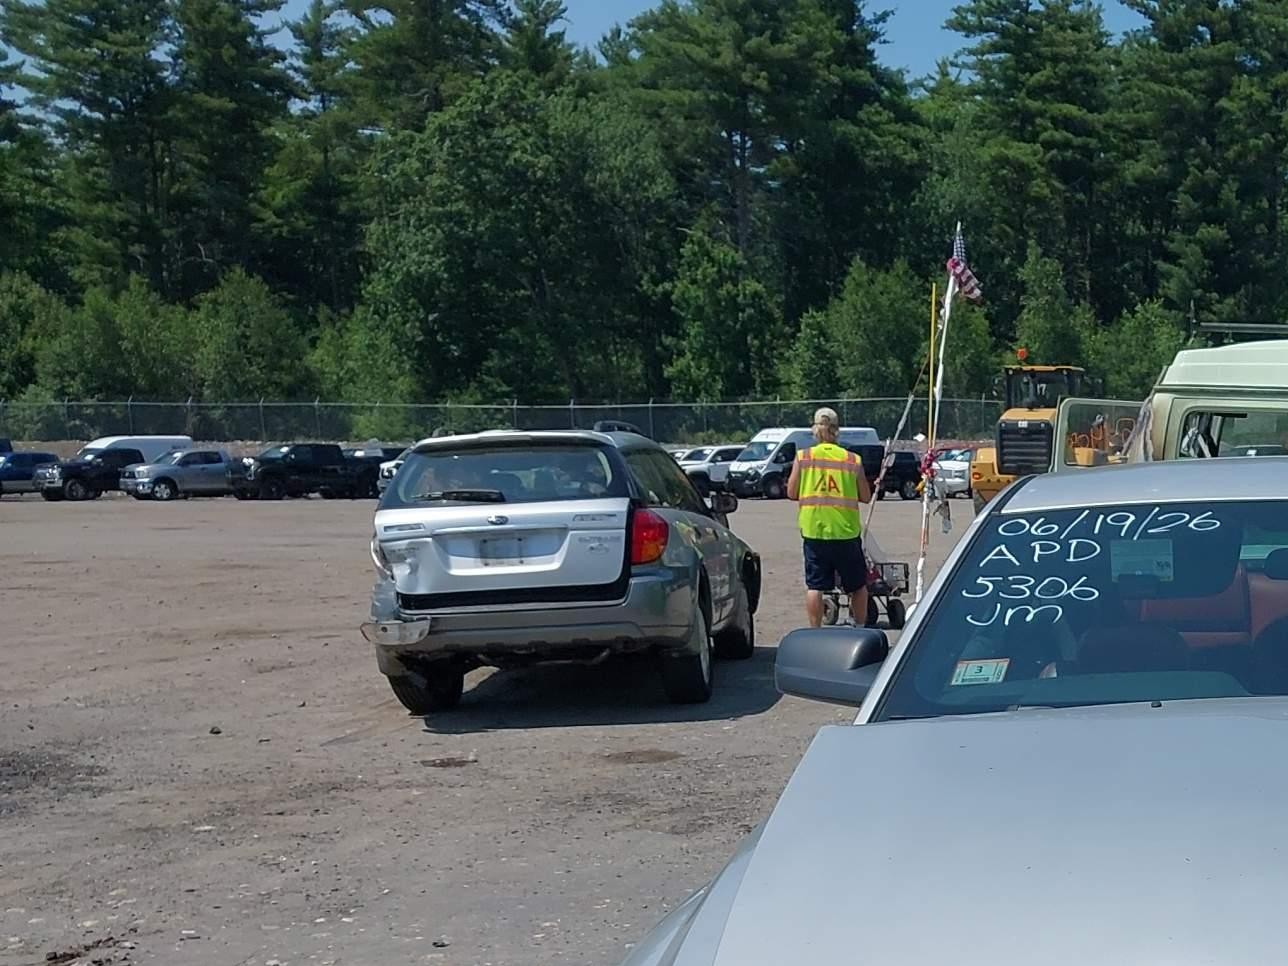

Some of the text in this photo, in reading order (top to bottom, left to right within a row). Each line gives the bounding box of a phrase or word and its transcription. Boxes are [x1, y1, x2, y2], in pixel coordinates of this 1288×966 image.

[998, 507, 1221, 541] 06/19/26
[961, 575, 1099, 601] 5306
[974, 665, 984, 674] 3
